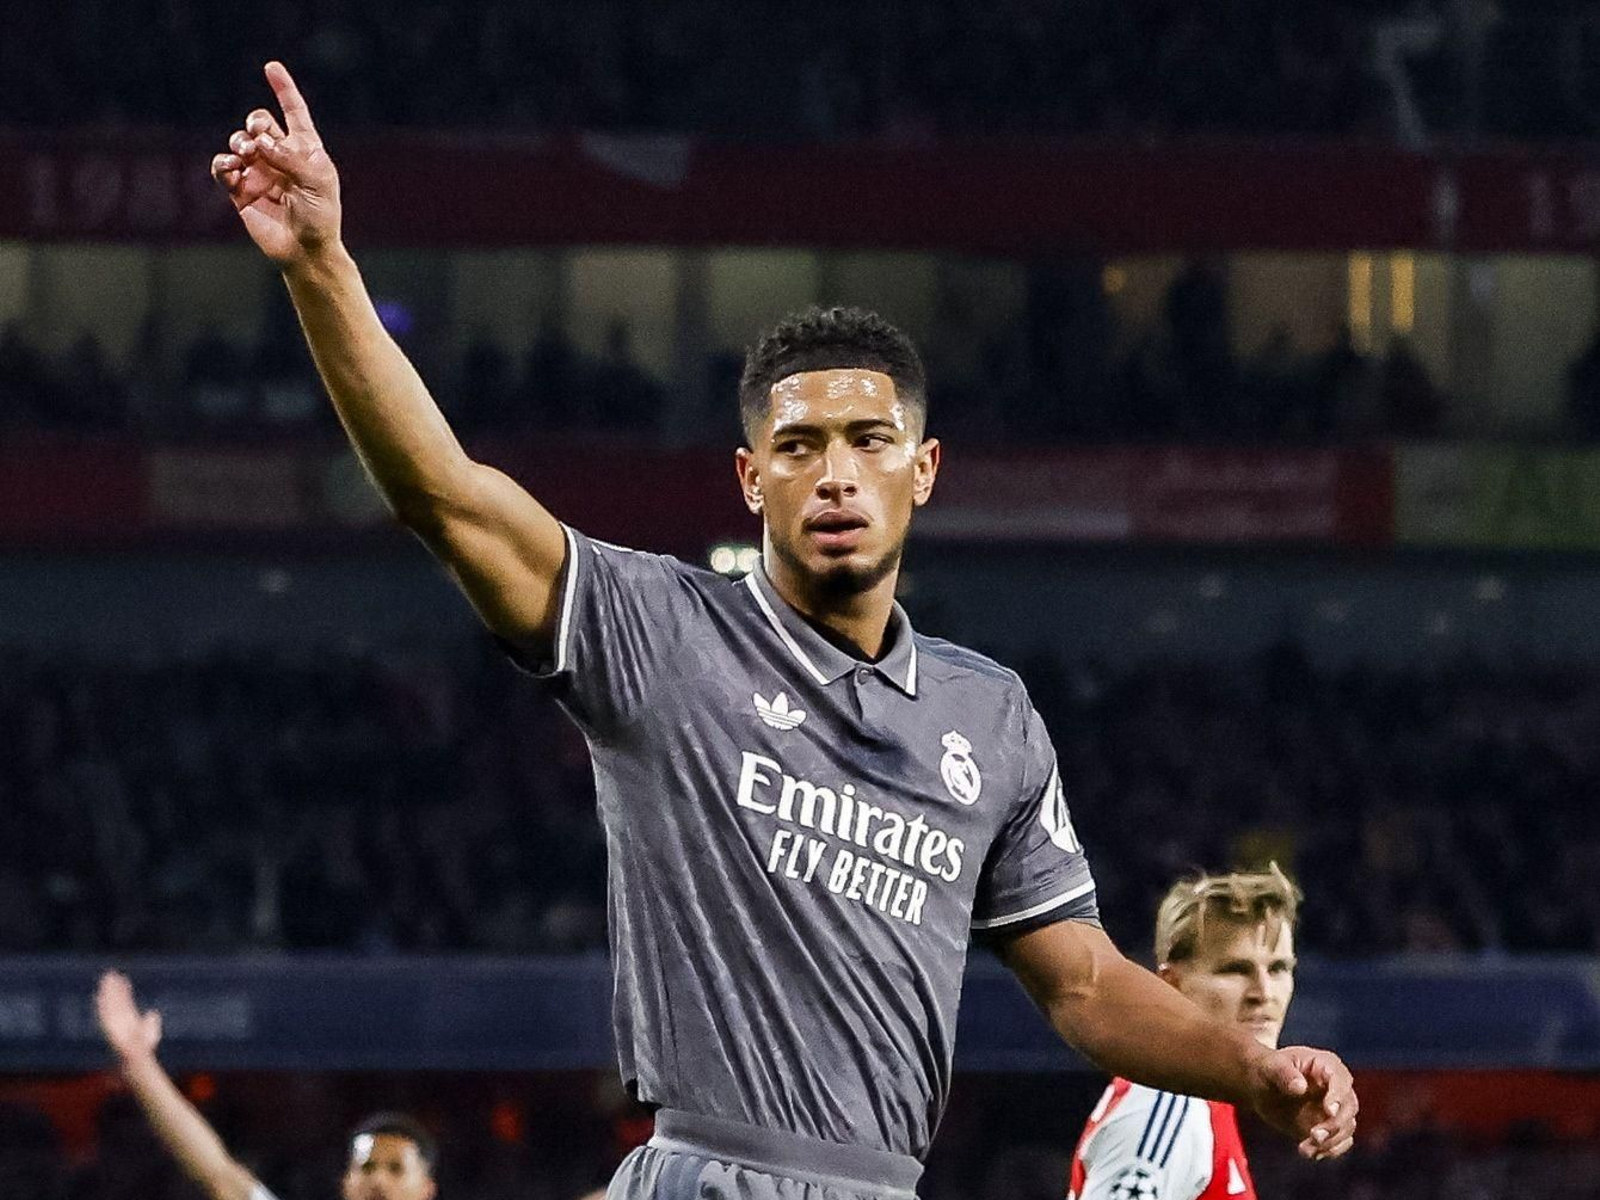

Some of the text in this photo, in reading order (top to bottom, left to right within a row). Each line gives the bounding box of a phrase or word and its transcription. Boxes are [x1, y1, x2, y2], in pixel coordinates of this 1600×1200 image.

[736, 751, 966, 883] Emirates
[766, 829, 929, 926] FLY BETTER
